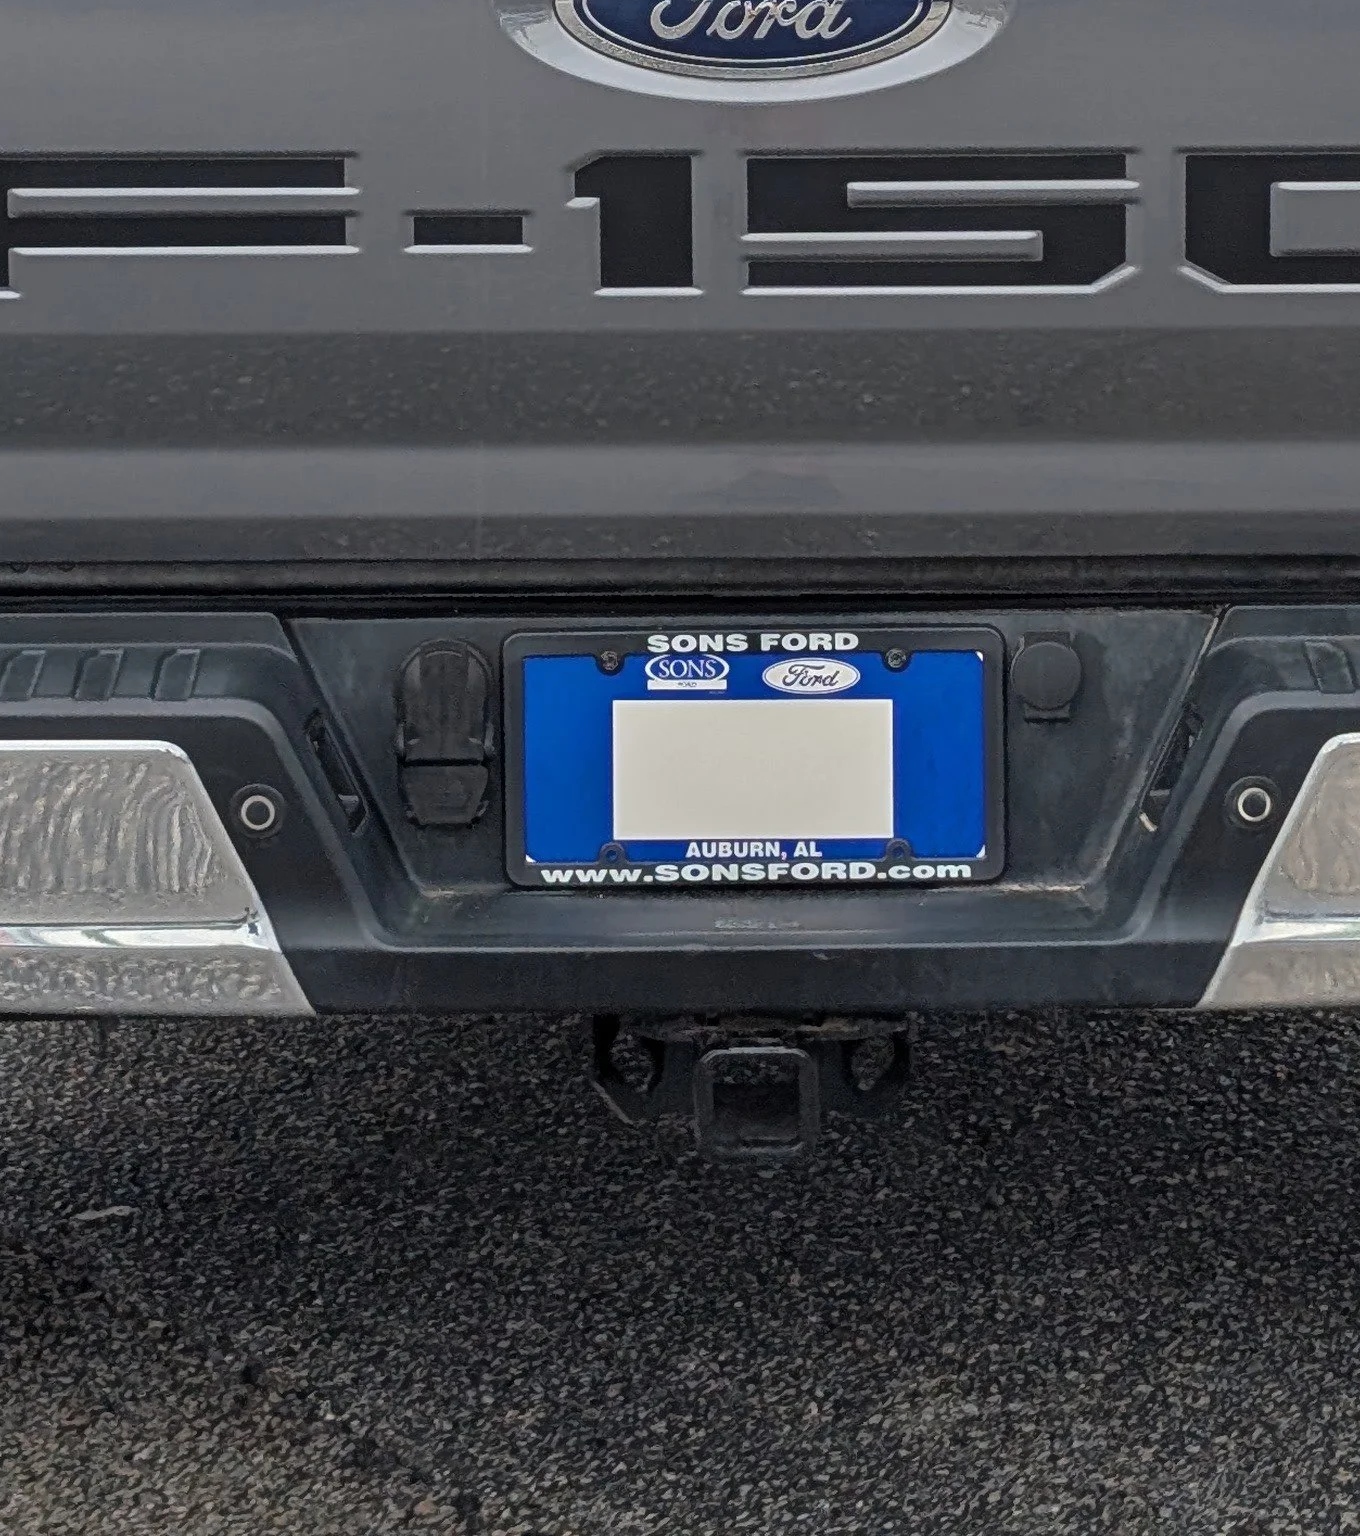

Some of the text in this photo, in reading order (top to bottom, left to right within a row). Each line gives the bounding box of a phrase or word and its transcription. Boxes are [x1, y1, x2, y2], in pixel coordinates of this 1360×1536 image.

[646, 632, 859, 653] SONS FORD
[658, 659, 717, 679] SONS
[782, 664, 841, 687] Ford
[685, 841, 823, 860] AUBURN, AL
[540, 862, 972, 883] www.SONSFORD.com
